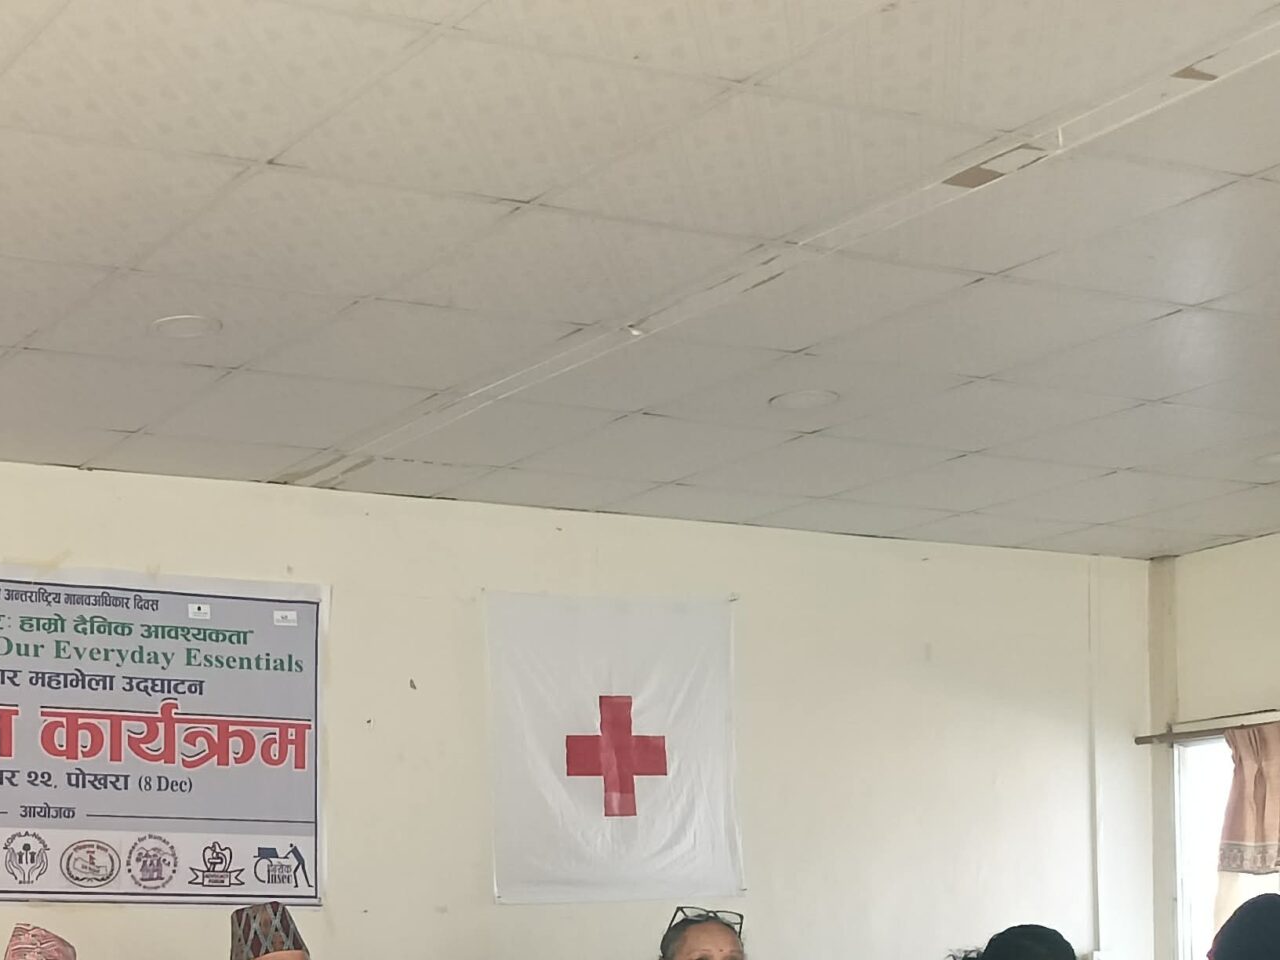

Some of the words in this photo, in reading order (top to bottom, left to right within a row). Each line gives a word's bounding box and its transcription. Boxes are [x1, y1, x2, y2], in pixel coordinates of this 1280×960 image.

[133, 594, 160, 612] दिवस
[19, 612, 67, 634] हाम्रो
[73, 613, 135, 638] दैनिक
[53, 639, 176, 670] Everyday
[185, 647, 304, 673] Essentials
[39, 698, 313, 771] कार्यक्रम
[66, 768, 130, 792] पोखरा
[156, 776, 193, 795] Dec)
[19, 802, 76, 820] आयोजक
